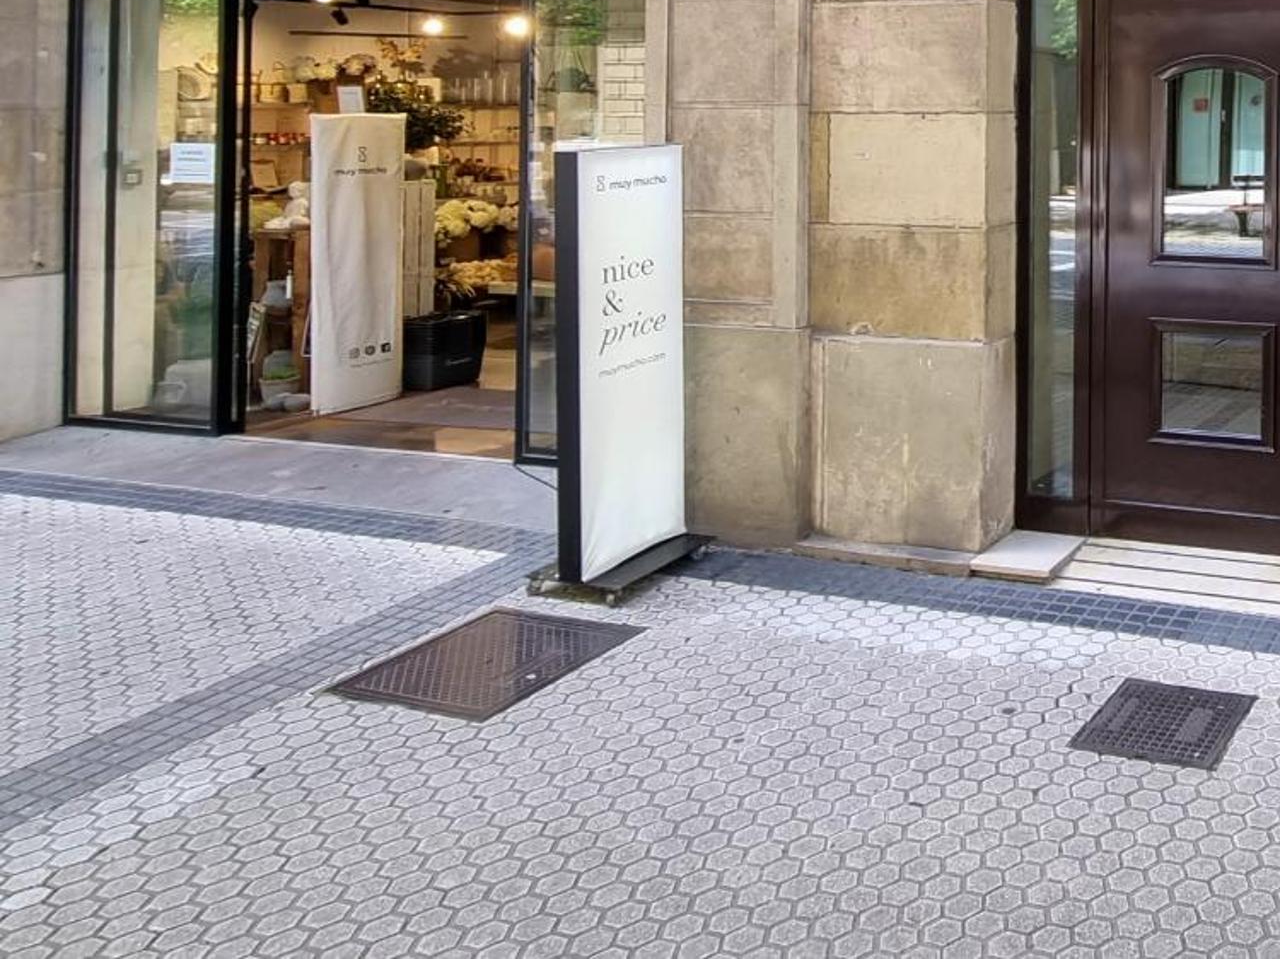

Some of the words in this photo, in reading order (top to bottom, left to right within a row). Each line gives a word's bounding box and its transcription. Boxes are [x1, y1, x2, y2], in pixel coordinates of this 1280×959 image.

[602, 255, 655, 285] nice
[602, 289, 623, 317] &
[599, 311, 667, 356] price
